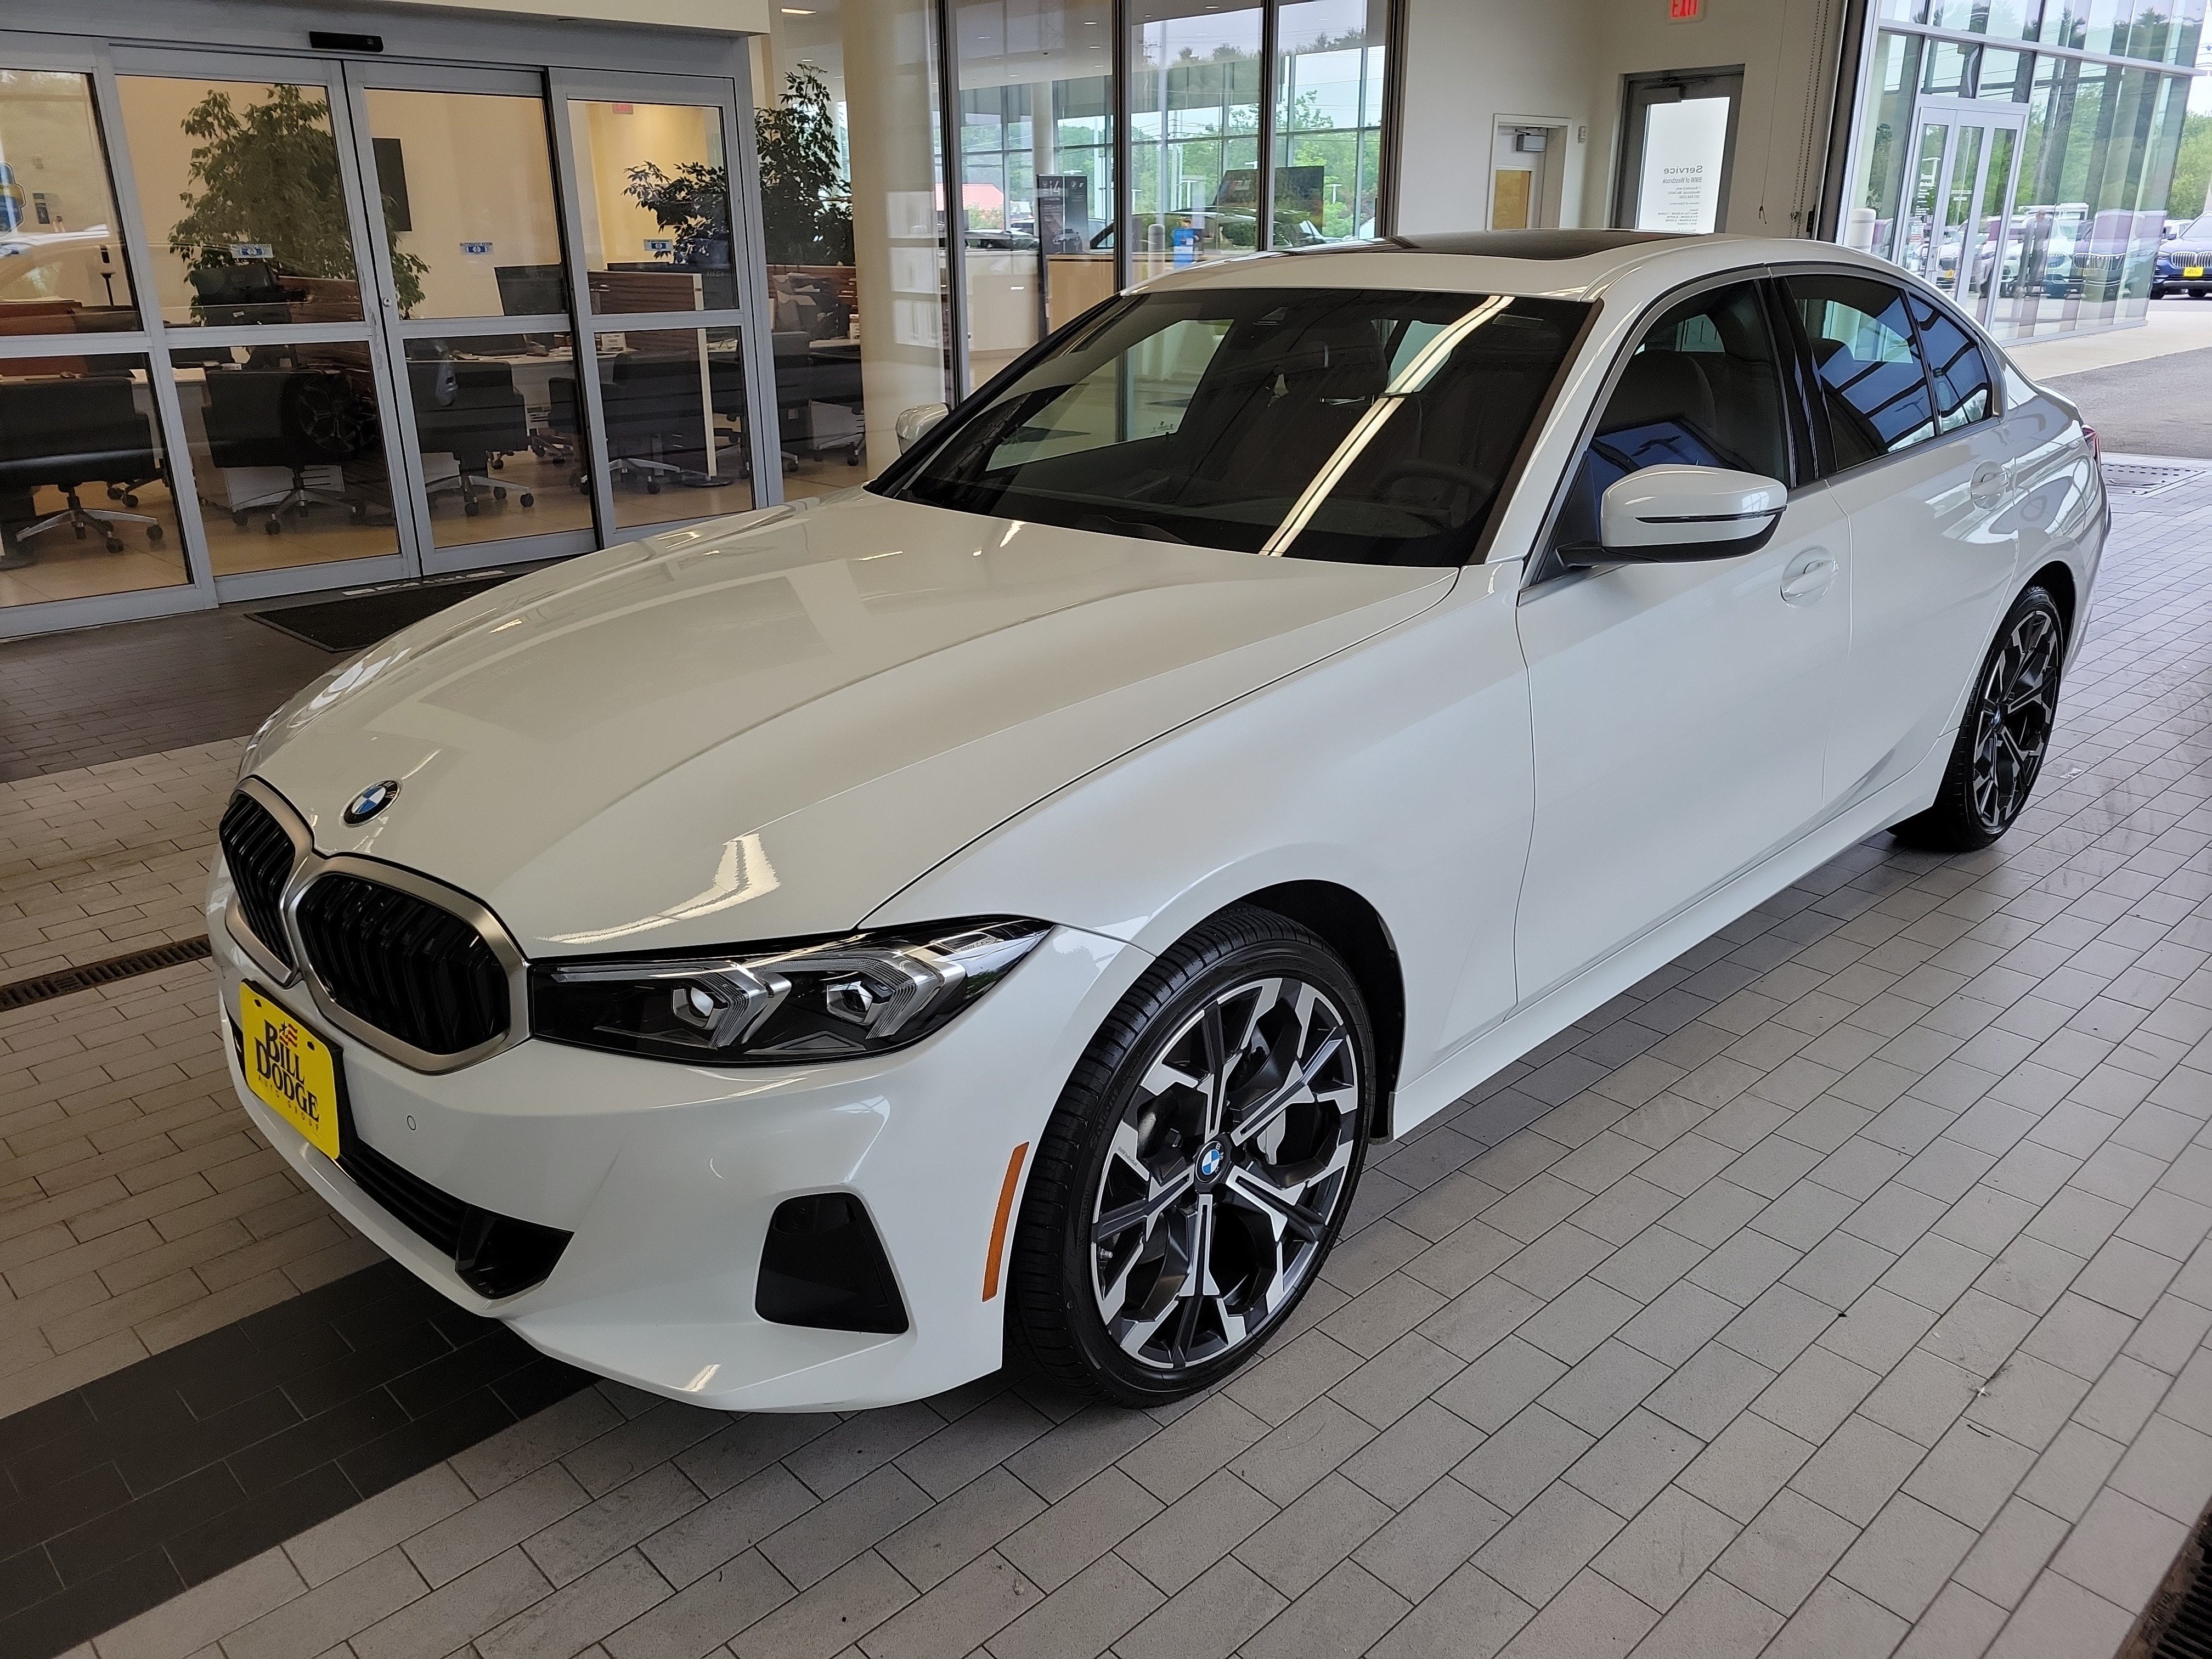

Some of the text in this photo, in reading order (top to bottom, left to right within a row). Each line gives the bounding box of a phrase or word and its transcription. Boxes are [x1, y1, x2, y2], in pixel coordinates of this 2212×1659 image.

[1049, 180, 1060, 195] i4
[961, 944, 975, 952] BMW
[264, 1019, 304, 1086] BILL
[255, 1036, 320, 1124] DODGE
